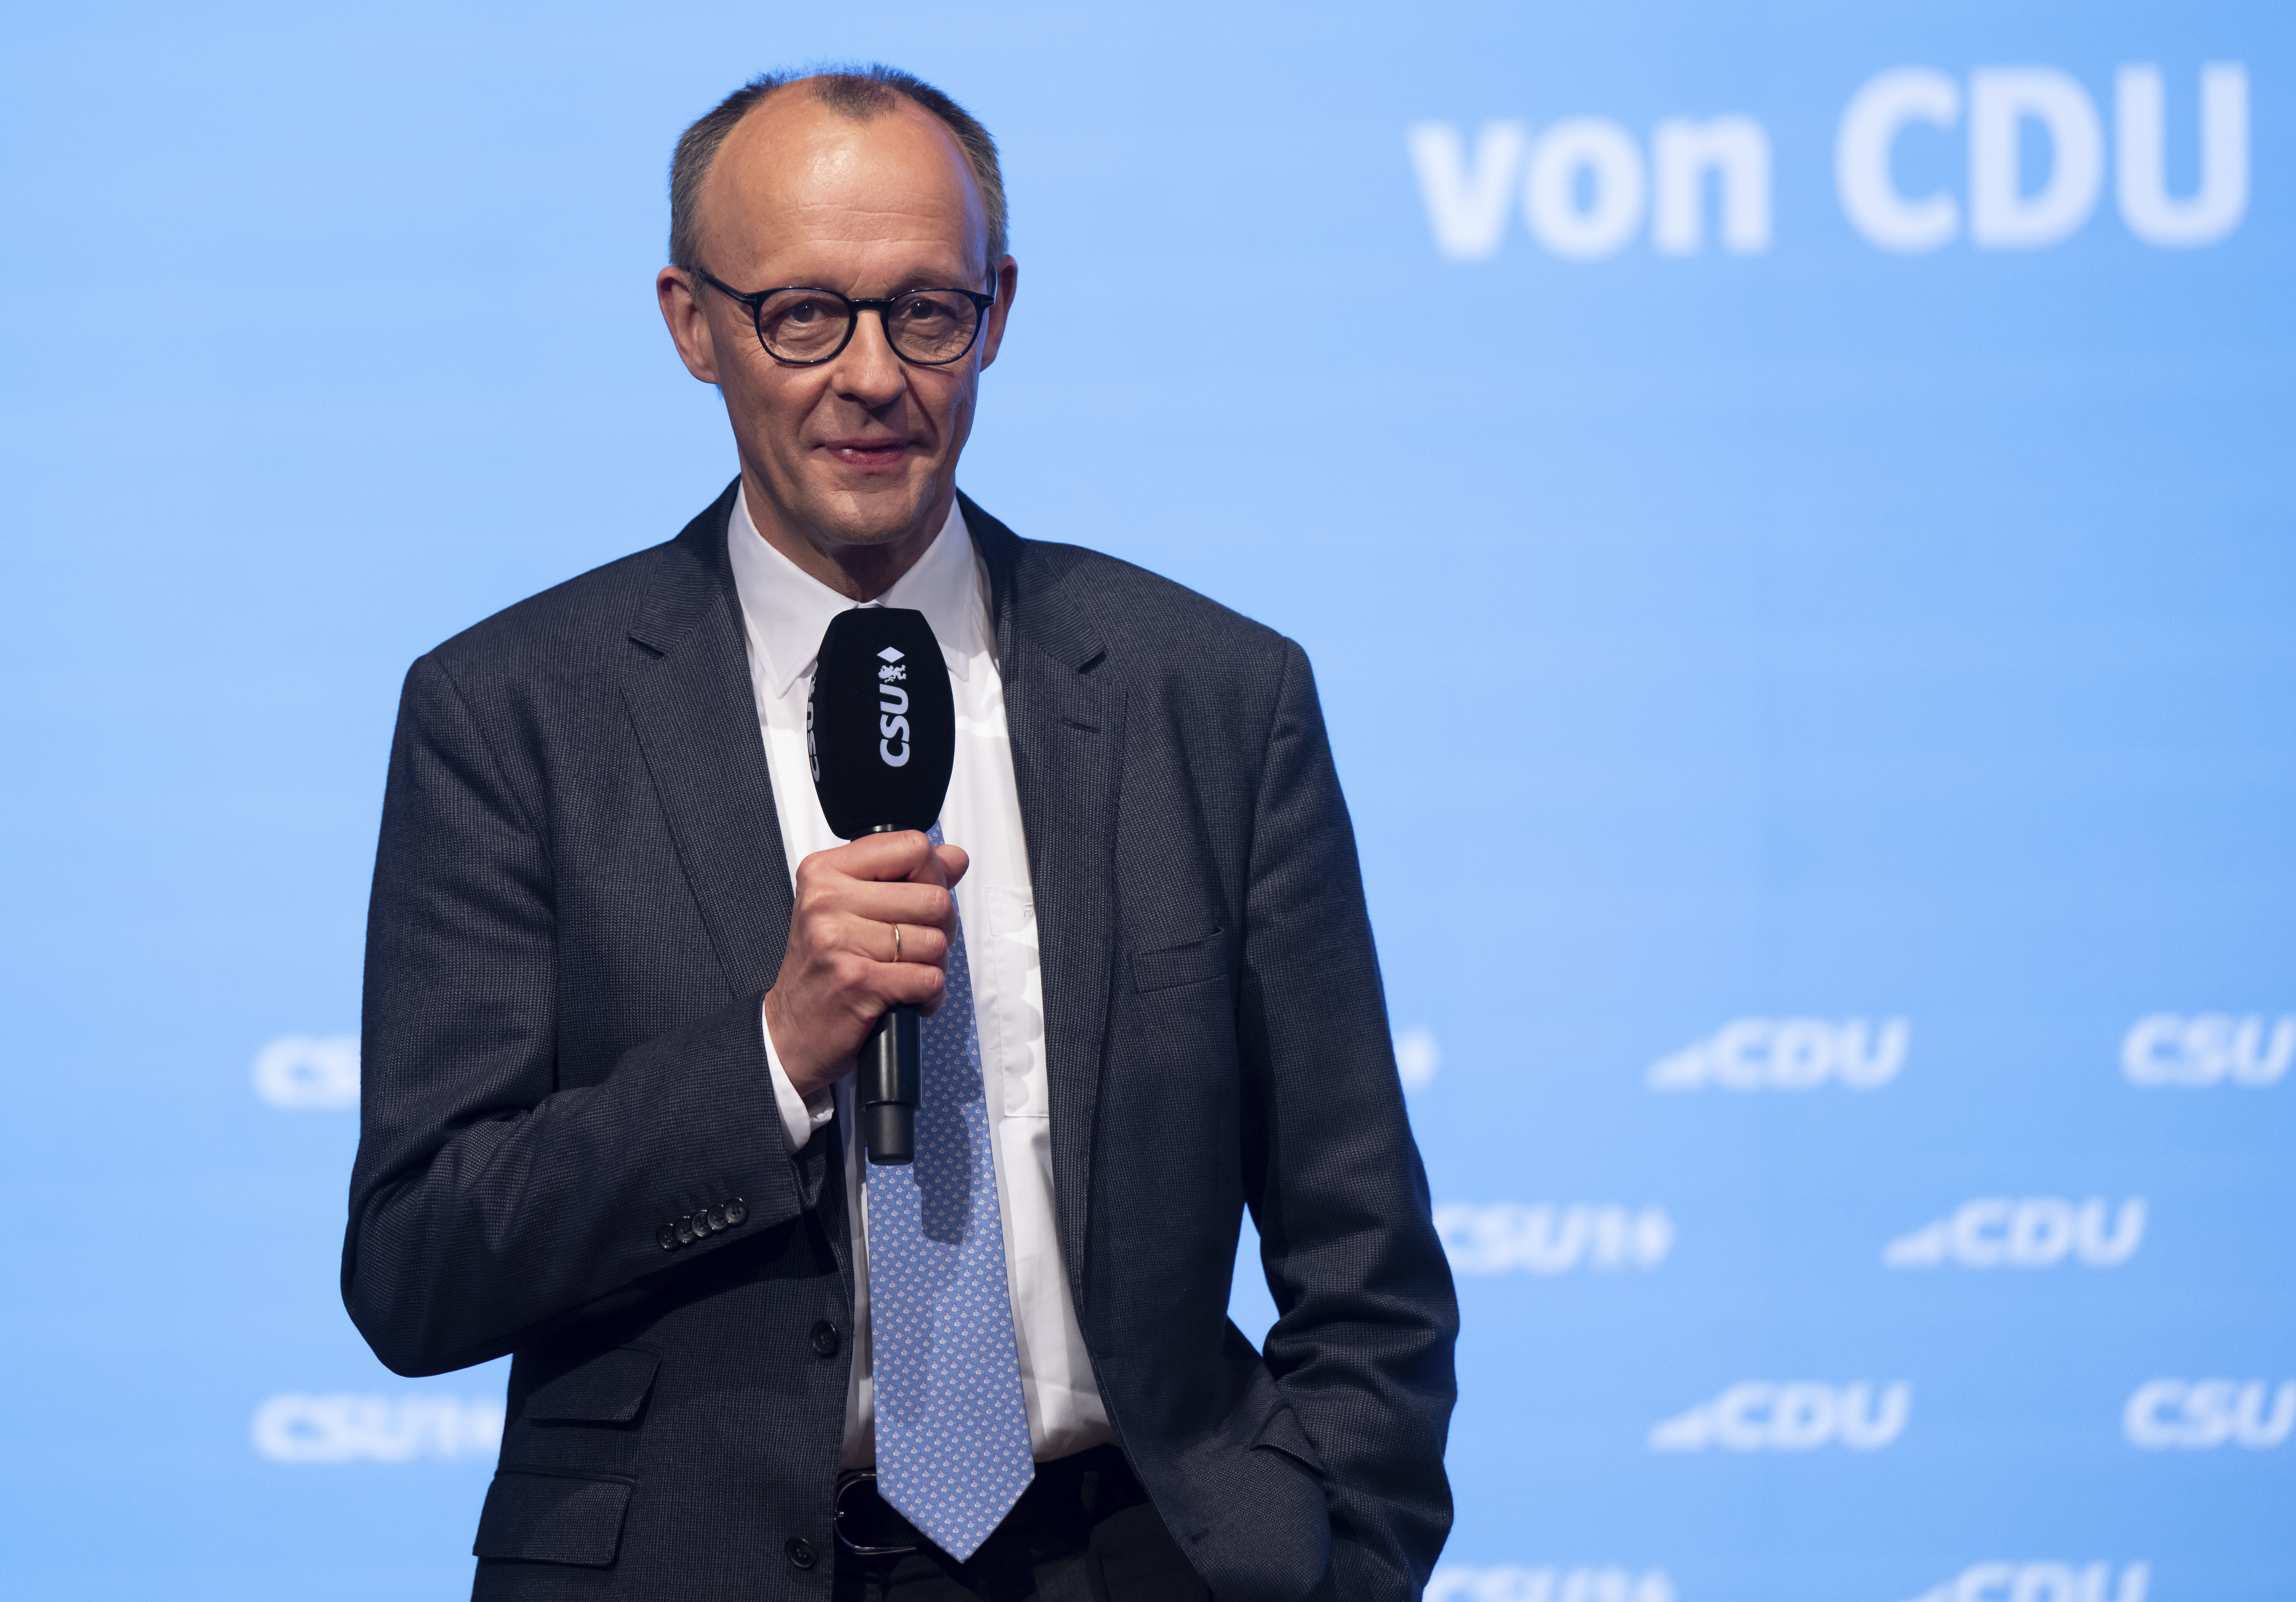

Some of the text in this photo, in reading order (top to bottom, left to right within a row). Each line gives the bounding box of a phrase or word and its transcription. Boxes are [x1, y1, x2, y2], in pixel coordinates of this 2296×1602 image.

[1408, 66, 2248, 260] von CDU
[880, 683, 910, 767] CSU
[254, 1036, 360, 1108] CS
[1715, 1018, 1907, 1089] CDU
[2120, 1015, 2296, 1086] CSU
[1952, 1199, 2145, 1267] CDU
[1716, 1382, 1909, 1451] CDU
[2123, 1380, 2296, 1448] CSU
